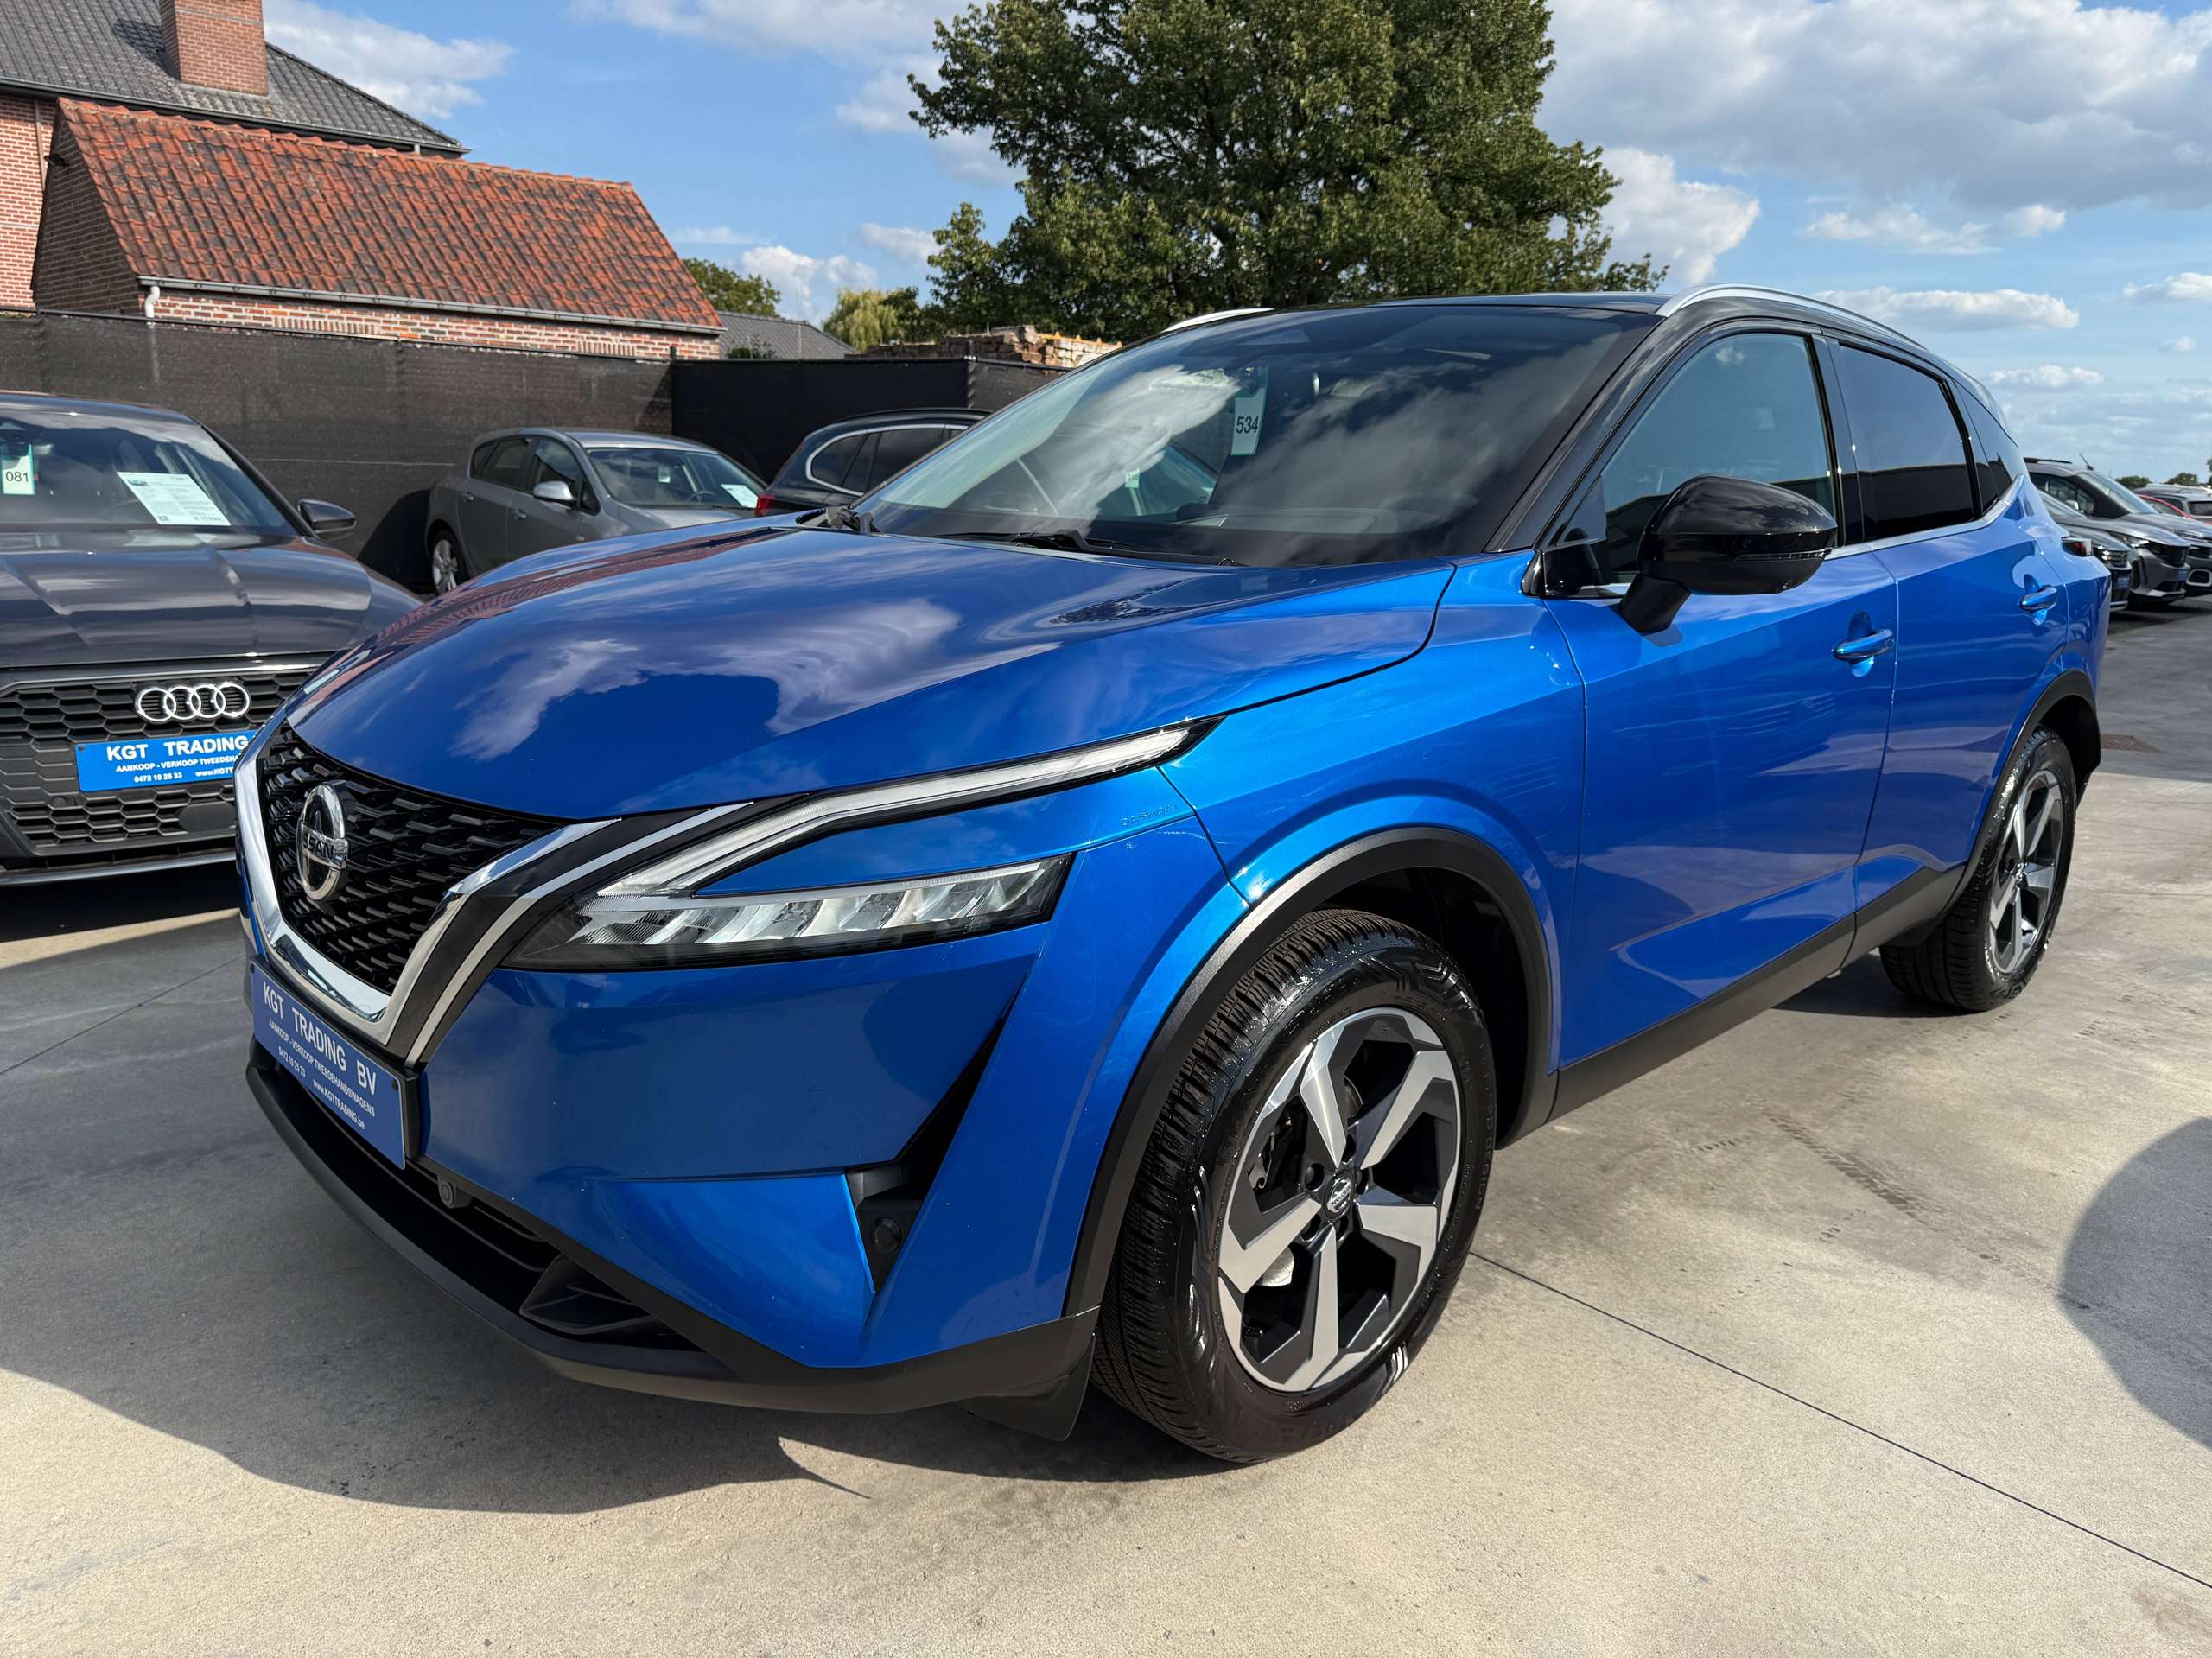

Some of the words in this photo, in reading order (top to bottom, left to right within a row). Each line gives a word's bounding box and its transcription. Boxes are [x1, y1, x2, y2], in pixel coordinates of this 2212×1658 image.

[1236, 416, 1259, 434] 534
[5, 471, 29, 482] 081
[106, 743, 149, 761] KGT
[163, 735, 249, 757] TRADING
[116, 761, 156, 773] AANKOOP
[161, 759, 199, 769] VERKOOP
[264, 981, 284, 1020] KGT
[292, 1007, 346, 1071] TRADING
[356, 1059, 376, 1096] BV
